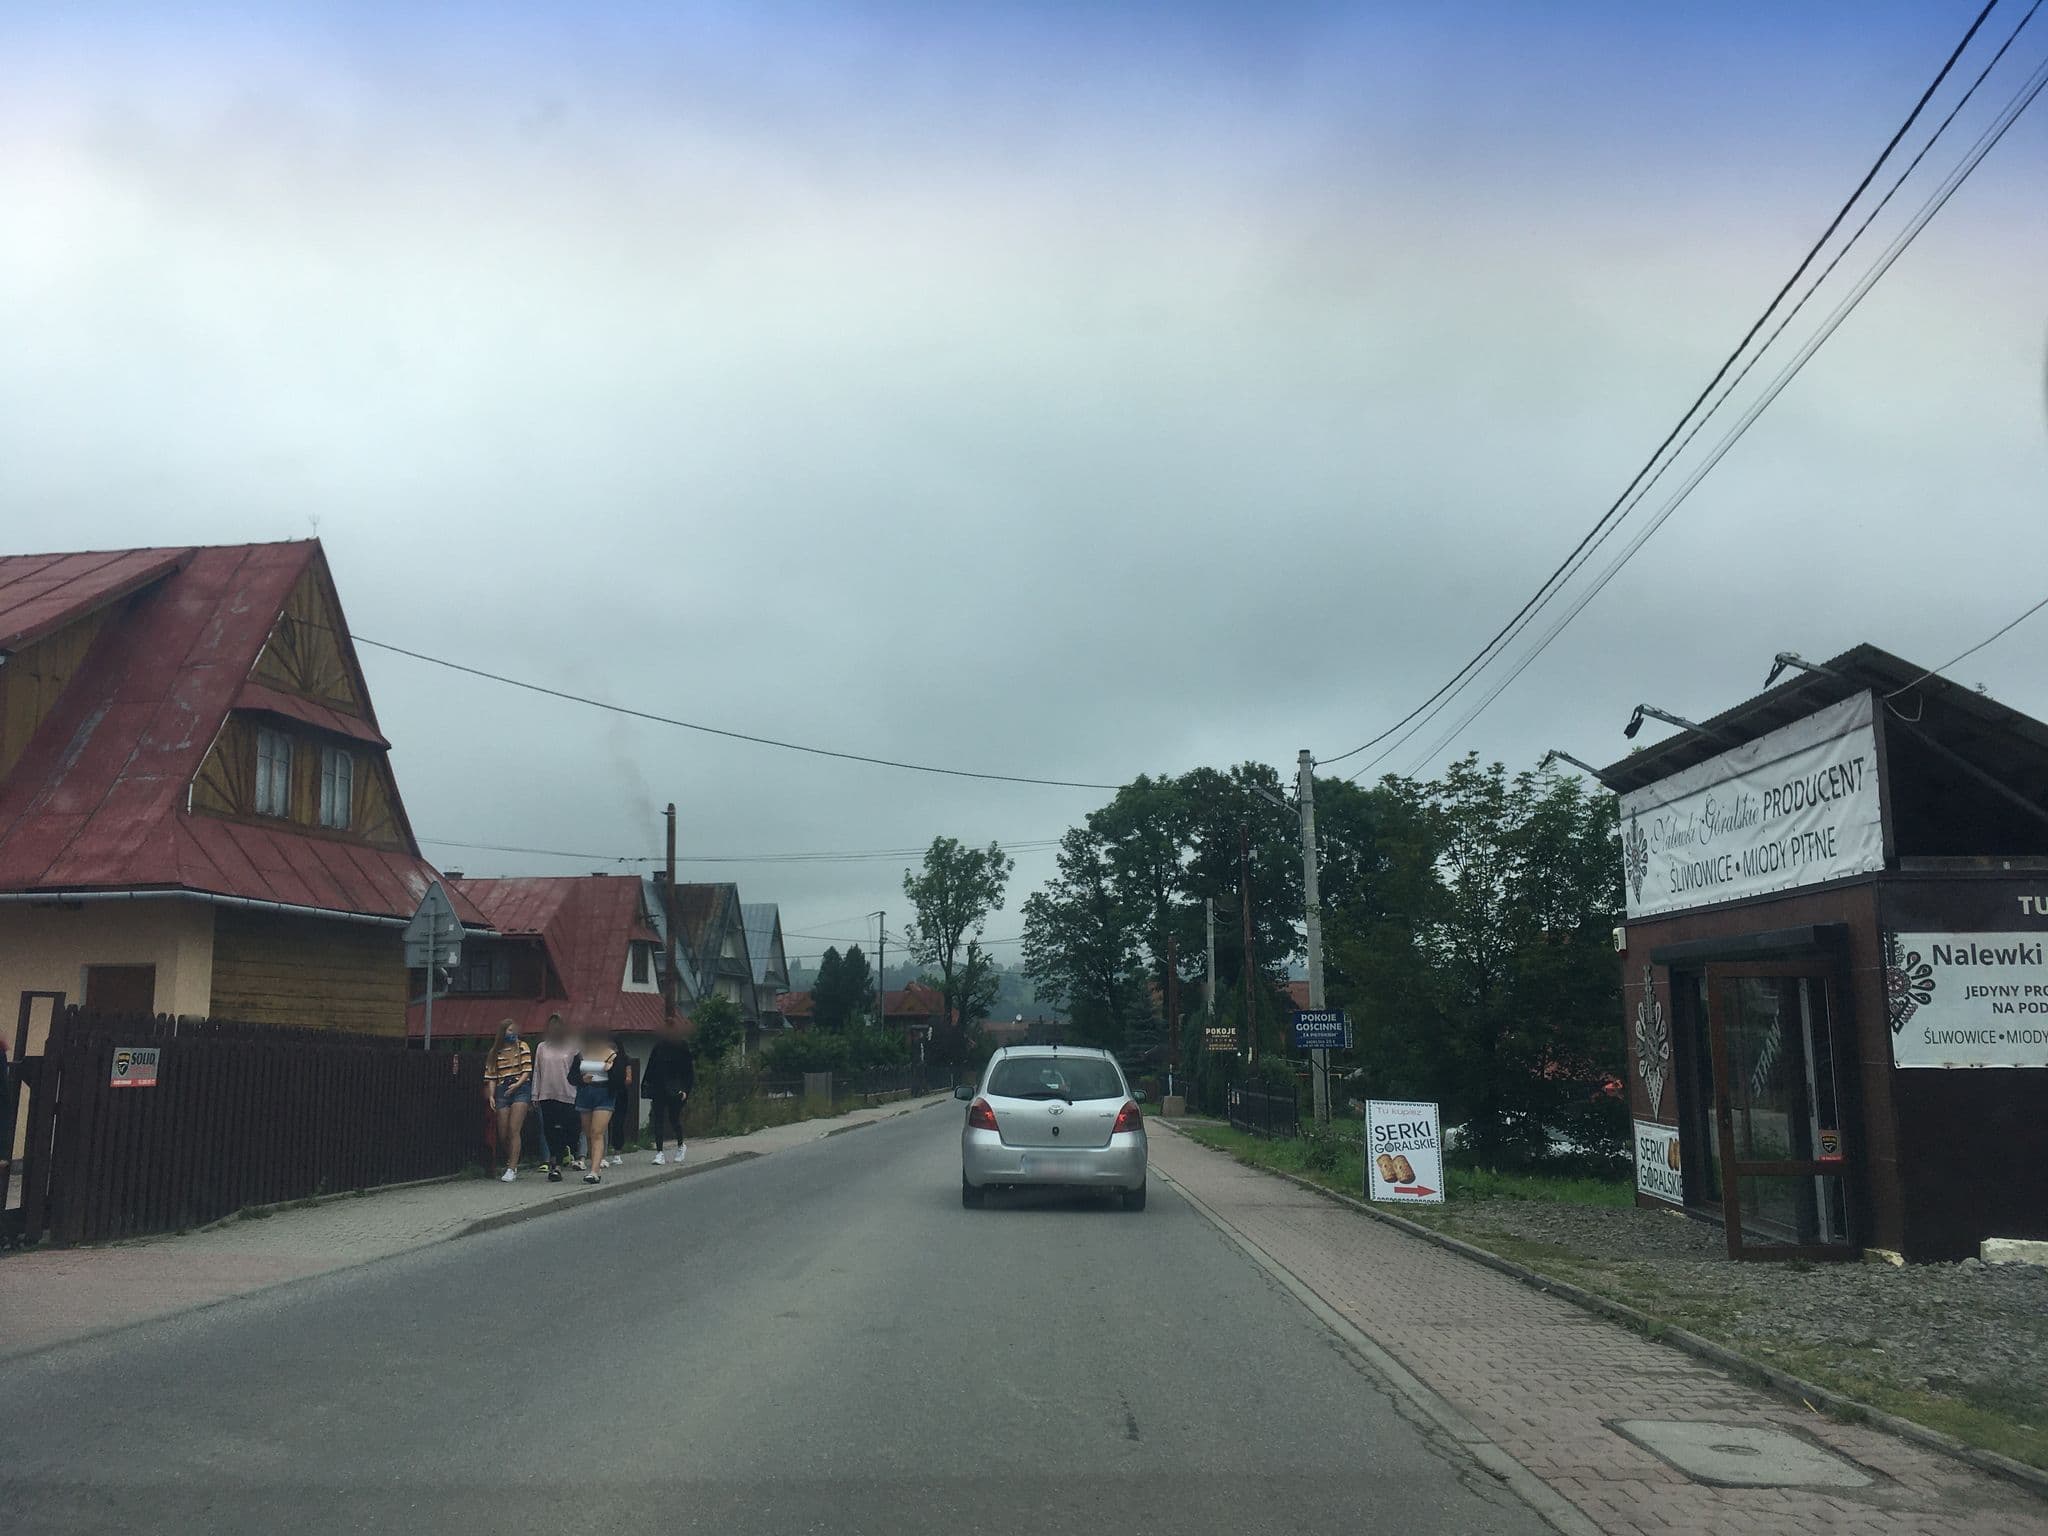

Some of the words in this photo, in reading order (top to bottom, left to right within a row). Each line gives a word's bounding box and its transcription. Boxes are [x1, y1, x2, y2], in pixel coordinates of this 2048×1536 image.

[1763, 757, 1865, 821] PRODUCENT
[1670, 854, 1733, 893] ŚLIWOWICE
[1743, 839, 1787, 877] MIODY
[1791, 826, 1838, 866] PITNE
[2017, 896, 2048, 916] TU
[1932, 943, 2043, 966] Nalewki
[1965, 986, 2020, 1000] JEDYNY
[1301, 1013, 1337, 1022] POKOJE
[1992, 1003, 2015, 1015] NA
[1206, 1027, 1236, 1035] POKOJE
[1924, 1027, 1997, 1045] ŚLIWOWICE
[2007, 1030, 2048, 1045] MIODY
[131, 1052, 155, 1065] SOLID
[1375, 1120, 1432, 1142] SERKI
[1374, 1138, 1437, 1154] GÓRALSKIE
[1640, 1136, 1666, 1165] SERKI
